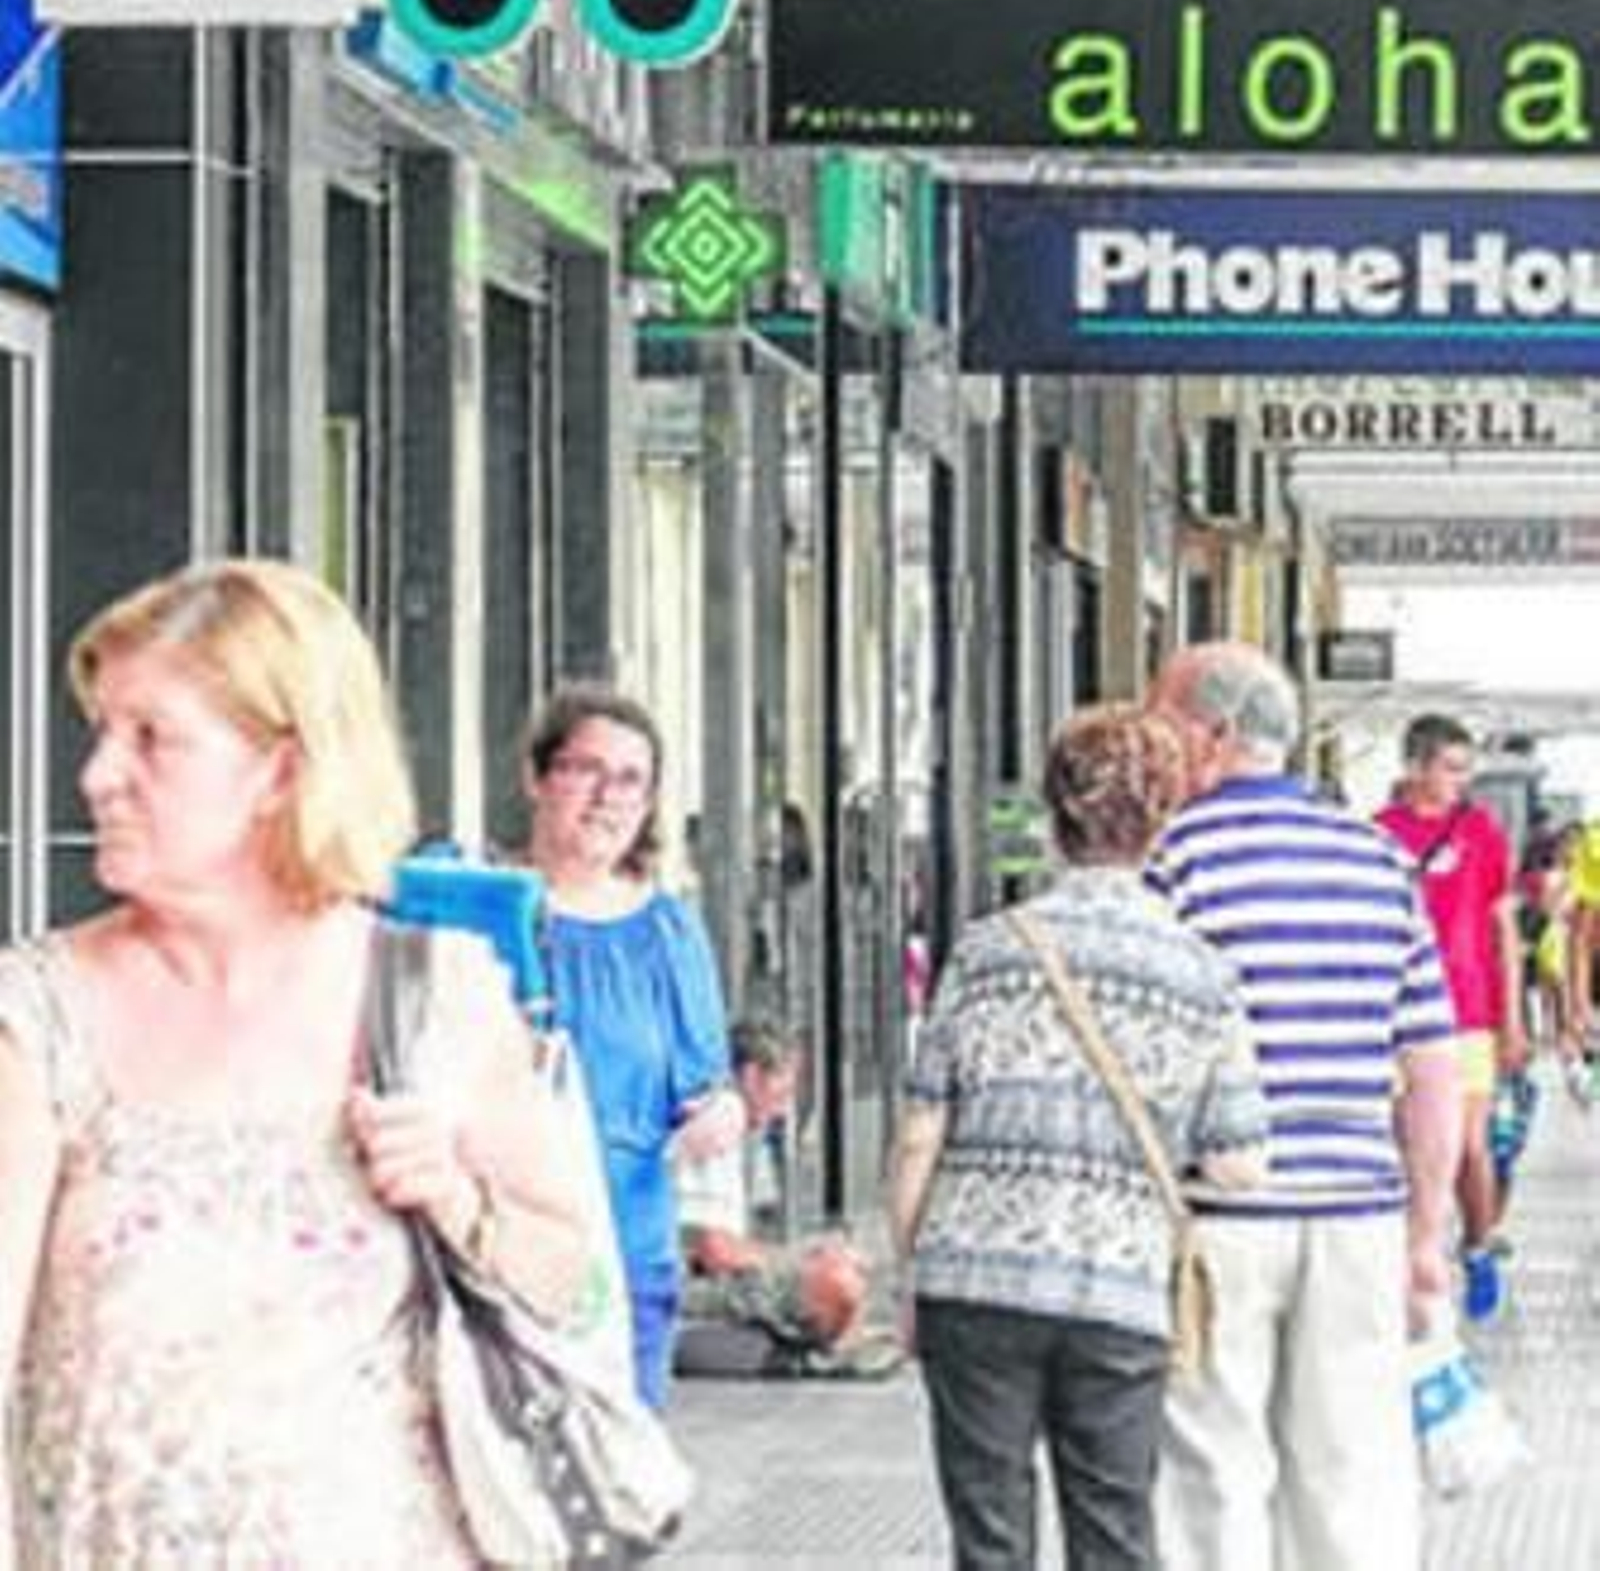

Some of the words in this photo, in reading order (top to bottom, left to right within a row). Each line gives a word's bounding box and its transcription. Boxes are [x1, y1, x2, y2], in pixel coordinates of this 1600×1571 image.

[1047, 4, 1588, 144] aloha
[1075, 228, 1404, 314] Phone
[1261, 401, 1556, 445] BORRELL
